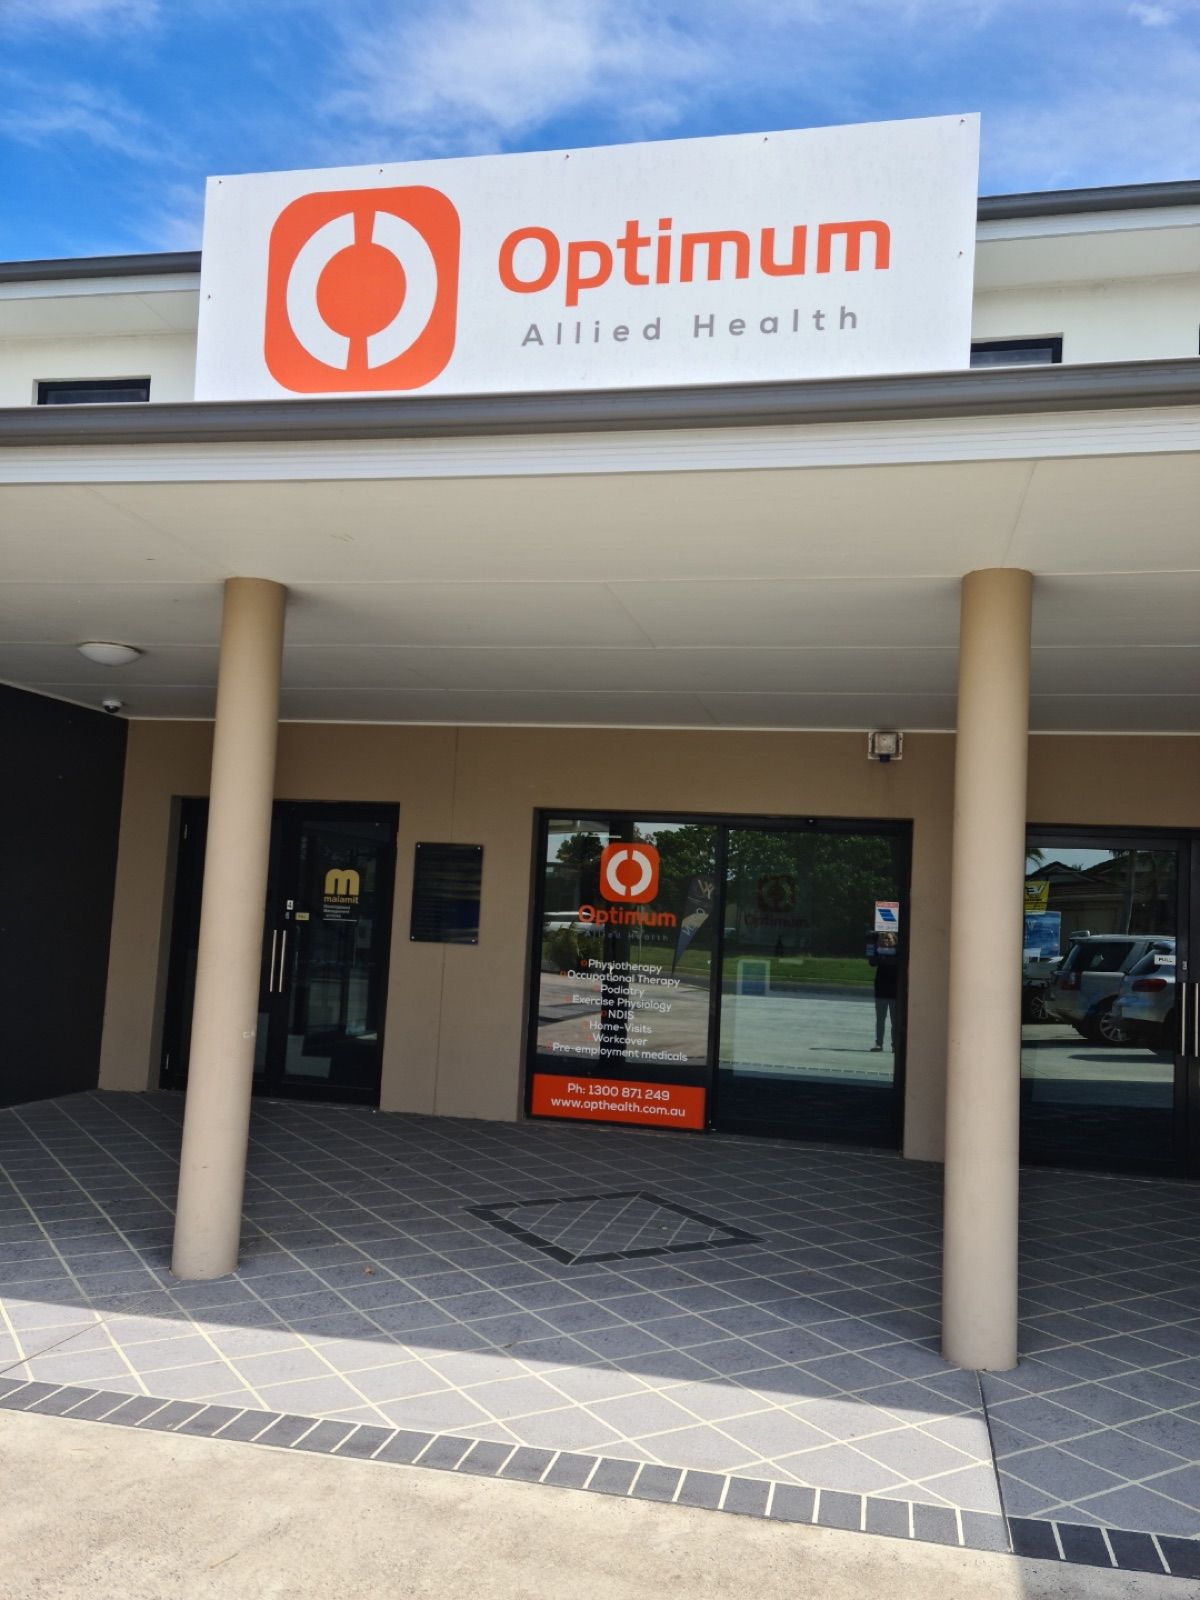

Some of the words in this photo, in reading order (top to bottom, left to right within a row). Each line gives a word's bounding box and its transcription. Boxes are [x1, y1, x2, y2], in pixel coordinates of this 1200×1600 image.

[498, 217, 891, 307] Optimum
[522, 317, 661, 347] Allied
[693, 306, 858, 339] Health
[578, 904, 677, 927] Optimum
[588, 958, 662, 975] Physiotherapy
[567, 970, 635, 983] Occupational
[637, 974, 681, 988] Therapy
[600, 984, 645, 998] Podiatry
[572, 995, 615, 1006] Exercise
[617, 998, 672, 1013] Physiology
[608, 1010, 635, 1020] NDIS
[589, 1021, 653, 1034] Home-Visits
[593, 1034, 649, 1046] Workcover
[552, 1042, 640, 1059] Pre-employment
[641, 1050, 688, 1062] medicals
[567, 1082, 586, 1094] Ph:
[588, 1085, 619, 1098] 1300
[622, 1087, 642, 1099] 871
[645, 1089, 670, 1101] 249
